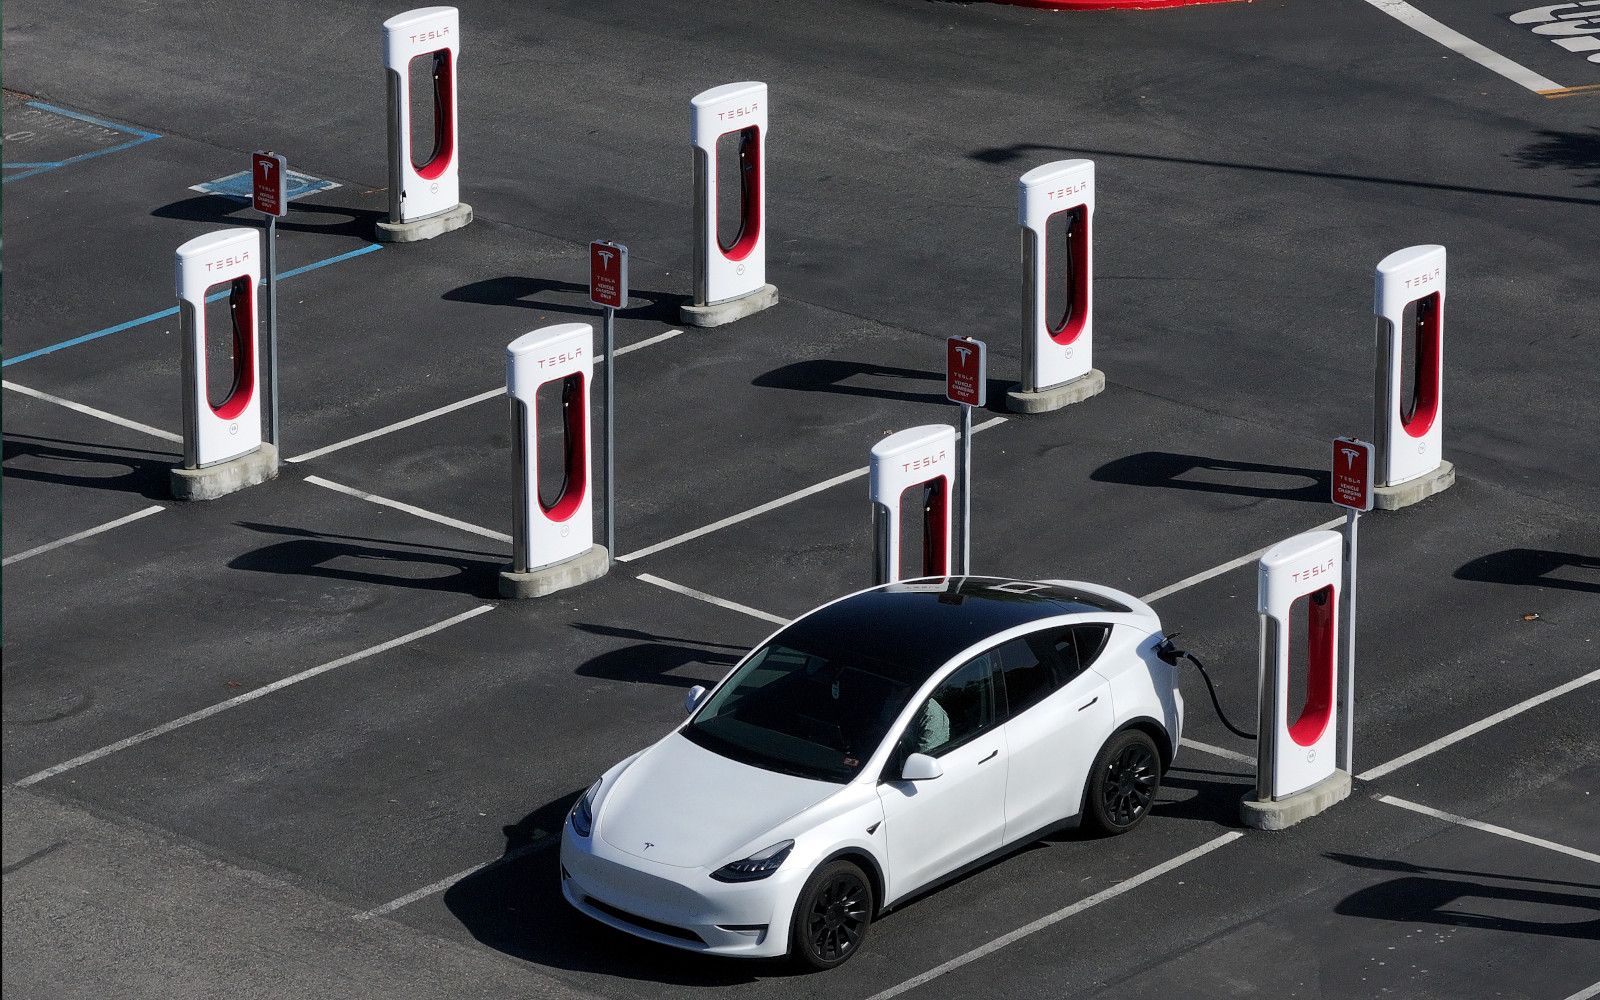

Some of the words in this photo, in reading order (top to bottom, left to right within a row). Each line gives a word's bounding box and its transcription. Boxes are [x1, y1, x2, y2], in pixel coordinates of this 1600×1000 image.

[409, 26, 449, 43] TESLA
[717, 103, 758, 121] TESLA
[1047, 181, 1086, 200] TESLA
[205, 251, 249, 272] TESLA
[597, 275, 615, 283] TESLA
[1404, 268, 1440, 288] TESLA
[537, 347, 583, 369] TESLA
[954, 372, 973, 380] TESLA
[902, 450, 946, 473] TESLA
[1340, 475, 1360, 484] TESLA
[1341, 483, 1359, 491] VEHICLE
[1338, 487, 1361, 497] CHARGING
[1292, 558, 1334, 583] TESLA
